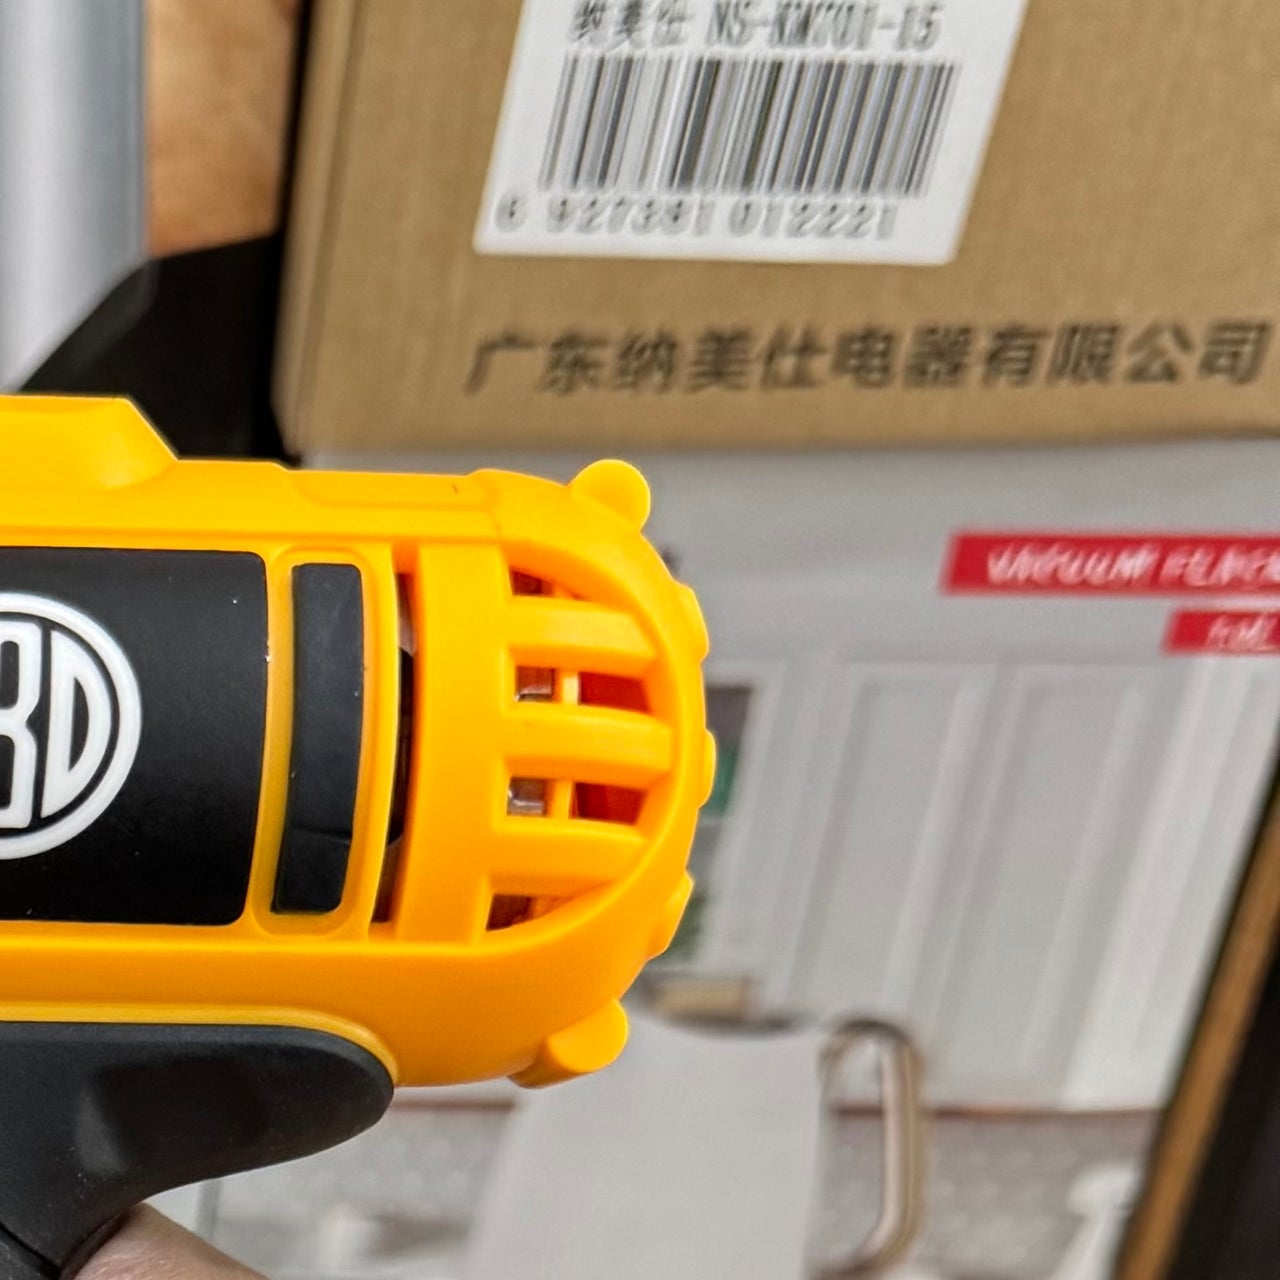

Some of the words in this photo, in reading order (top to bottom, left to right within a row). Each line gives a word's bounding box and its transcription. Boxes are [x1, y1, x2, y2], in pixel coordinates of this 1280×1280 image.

[729, 197, 899, 240] 012221
[463, 318, 1272, 395] 广东纳美仕电器有限公司
